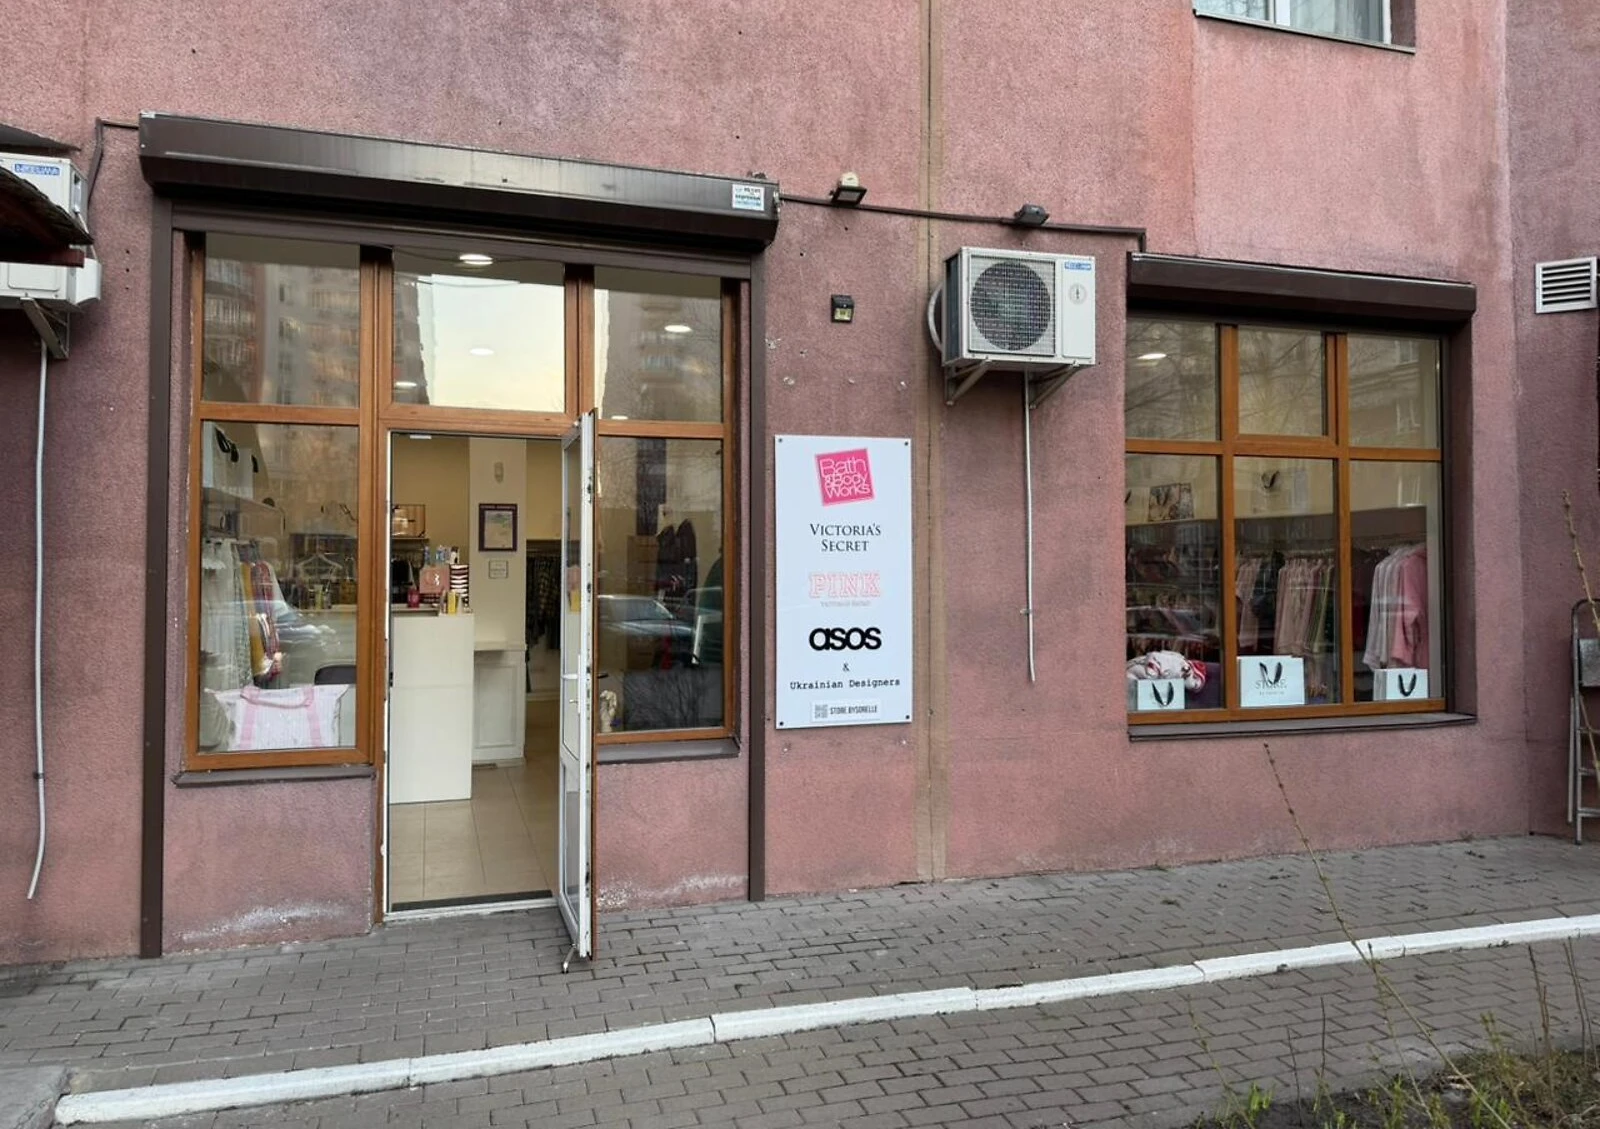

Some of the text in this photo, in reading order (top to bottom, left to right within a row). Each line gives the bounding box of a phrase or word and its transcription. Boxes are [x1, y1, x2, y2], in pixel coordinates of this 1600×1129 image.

[819, 457, 867, 477] Bath
[834, 472, 868, 486] Body
[825, 484, 871, 498] Works
[810, 523, 881, 536] VICTORIA'S
[821, 539, 869, 552] SECRET
[809, 571, 880, 598] PINK
[809, 627, 882, 651] asos
[842, 663, 850, 673] &
[790, 679, 900, 690] Ukrainian Designers
